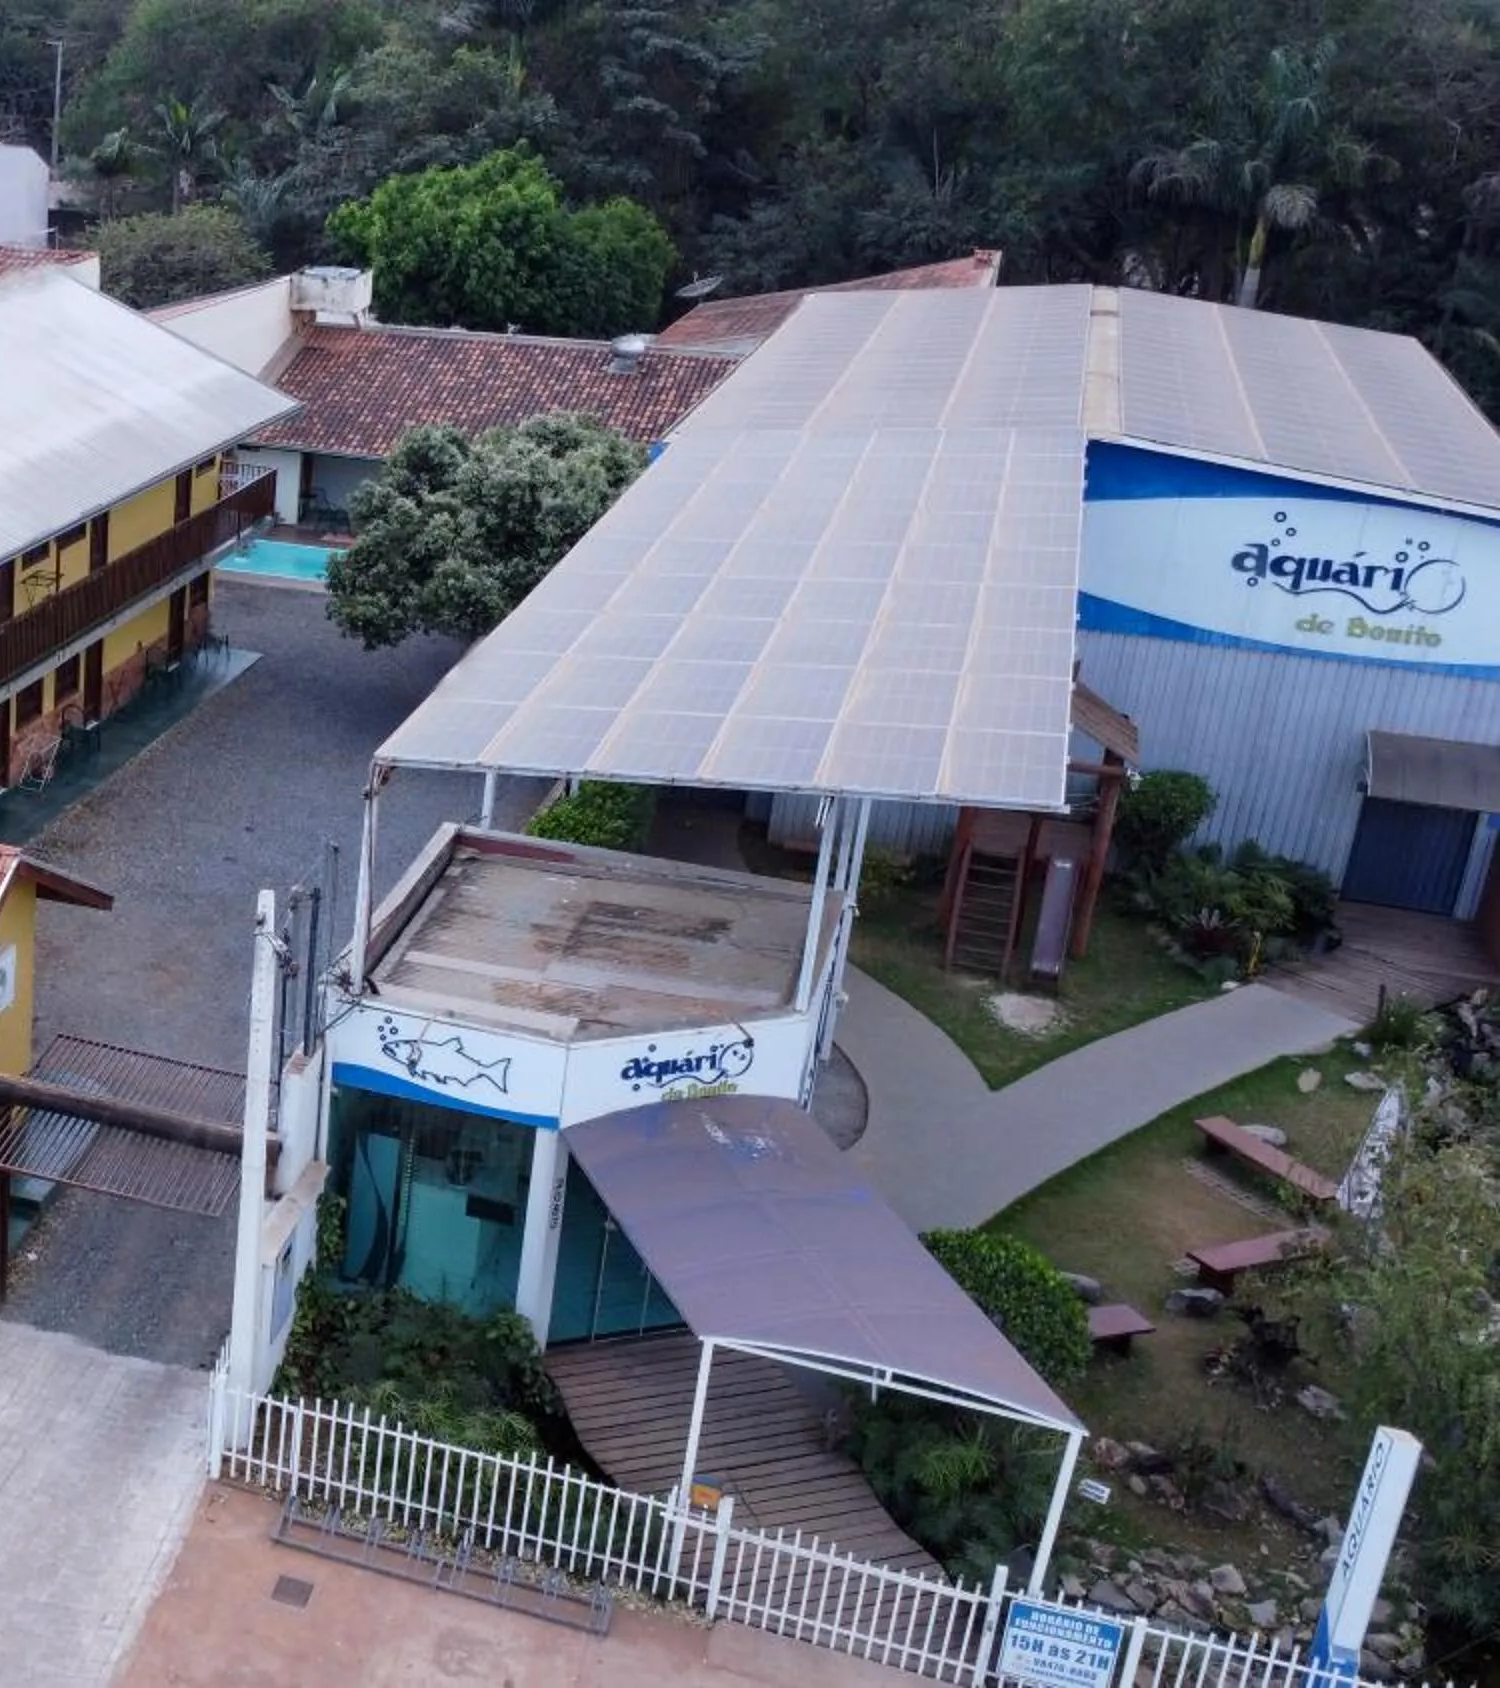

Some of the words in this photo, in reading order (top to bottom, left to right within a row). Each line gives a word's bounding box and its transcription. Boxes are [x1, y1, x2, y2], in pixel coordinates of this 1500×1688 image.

[1295, 613, 1335, 634] de
[1347, 615, 1442, 648] Bonito
[1011, 1634, 1045, 1654] 15H
[1075, 1649, 1112, 1671] 21H
